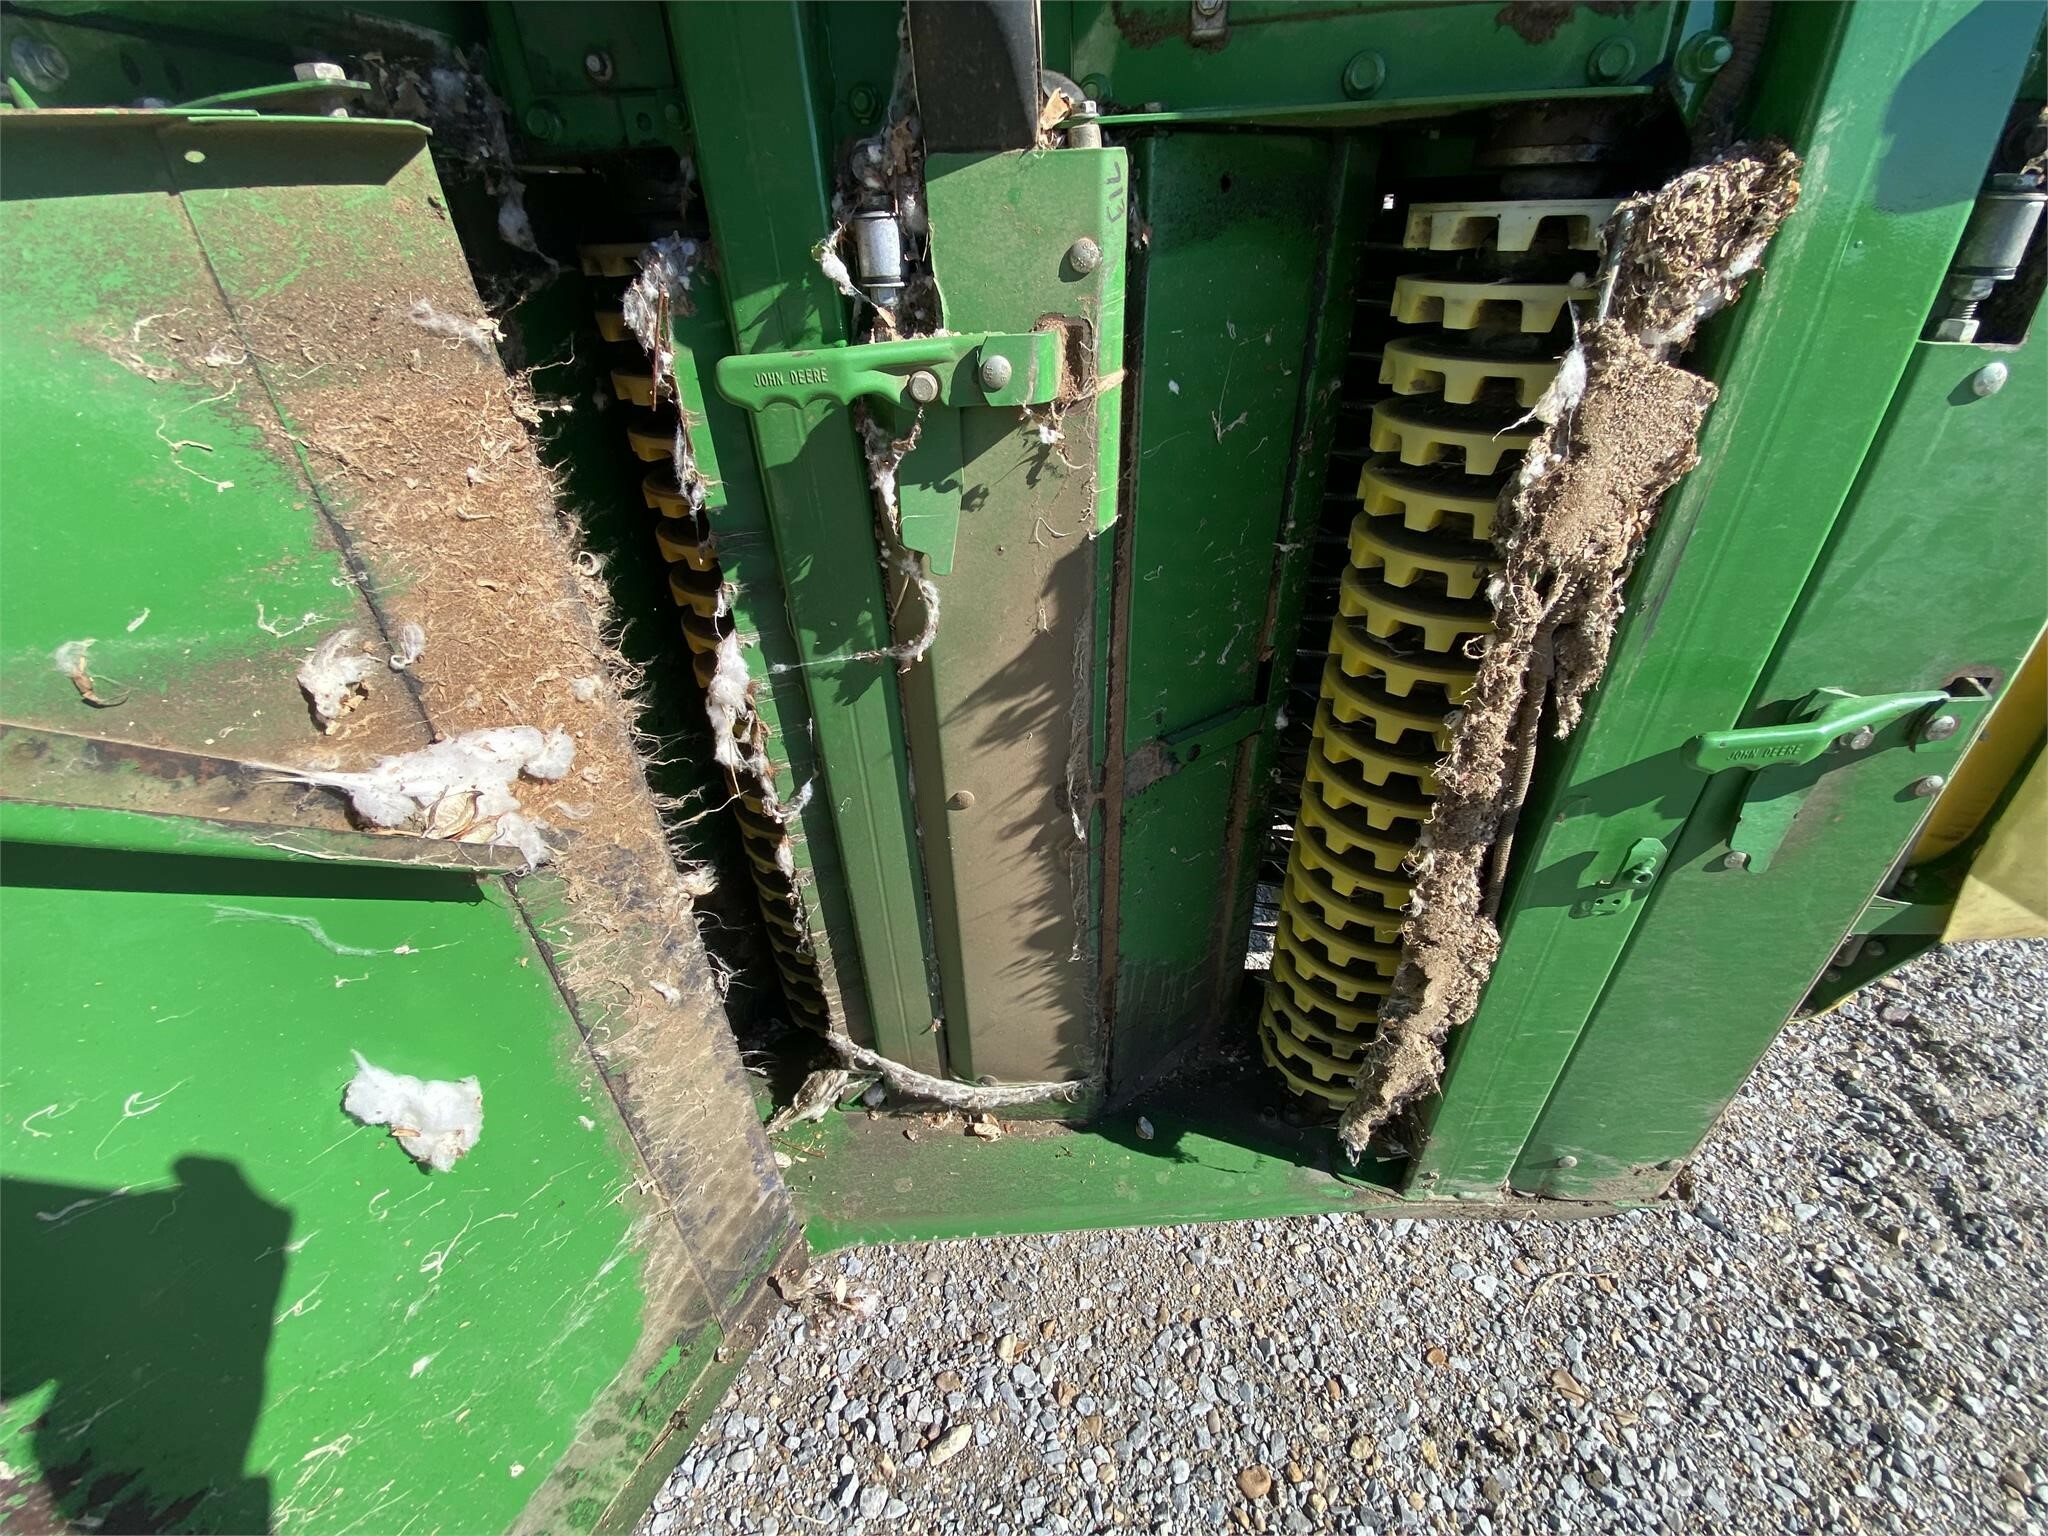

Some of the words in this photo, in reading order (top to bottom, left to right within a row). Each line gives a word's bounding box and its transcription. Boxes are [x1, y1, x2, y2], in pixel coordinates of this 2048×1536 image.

[753, 371, 785, 388] JOHN
[789, 367, 829, 386] DEERE
[1726, 747, 1760, 761] JOHN
[1761, 743, 1804, 759] DEERE
